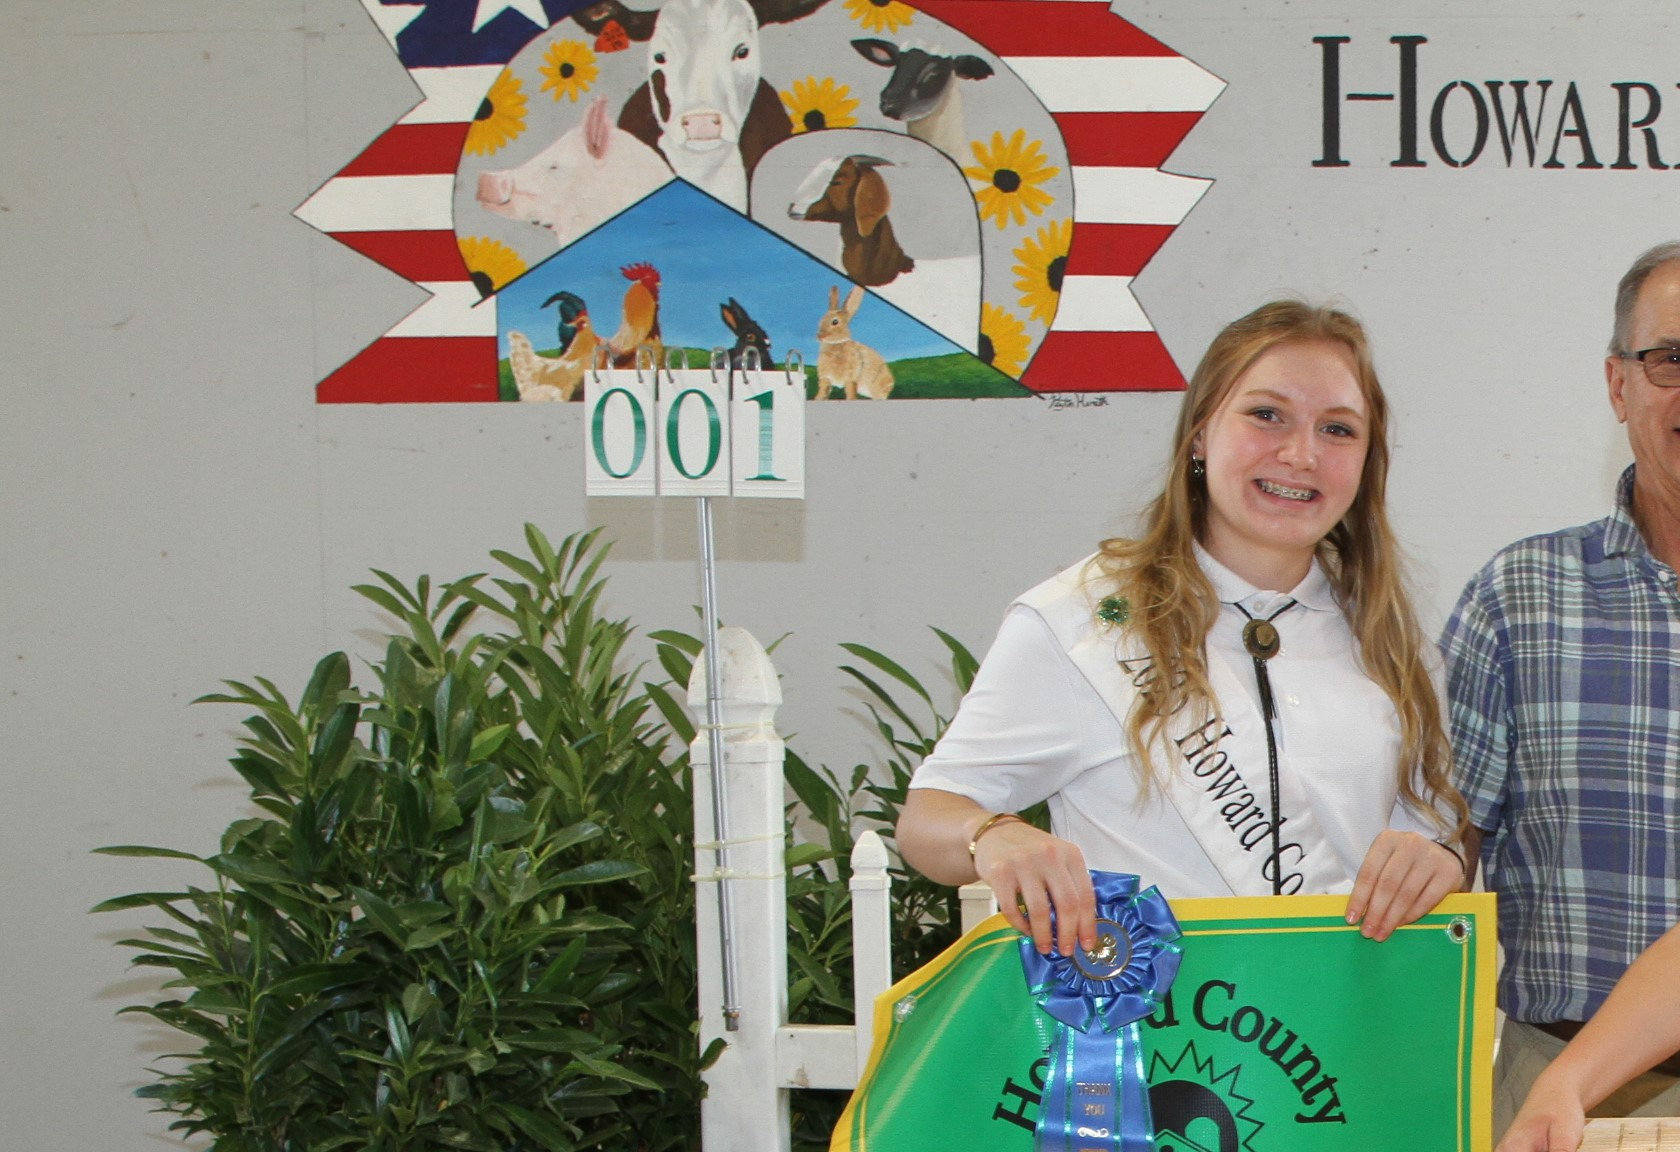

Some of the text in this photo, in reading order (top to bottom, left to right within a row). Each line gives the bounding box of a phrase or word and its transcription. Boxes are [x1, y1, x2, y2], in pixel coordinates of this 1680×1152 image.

[591, 387, 787, 481] 001
[1174, 717, 1287, 852] Howard
[1193, 979, 1347, 1125] County
[1084, 1103, 1105, 1116] YOU
